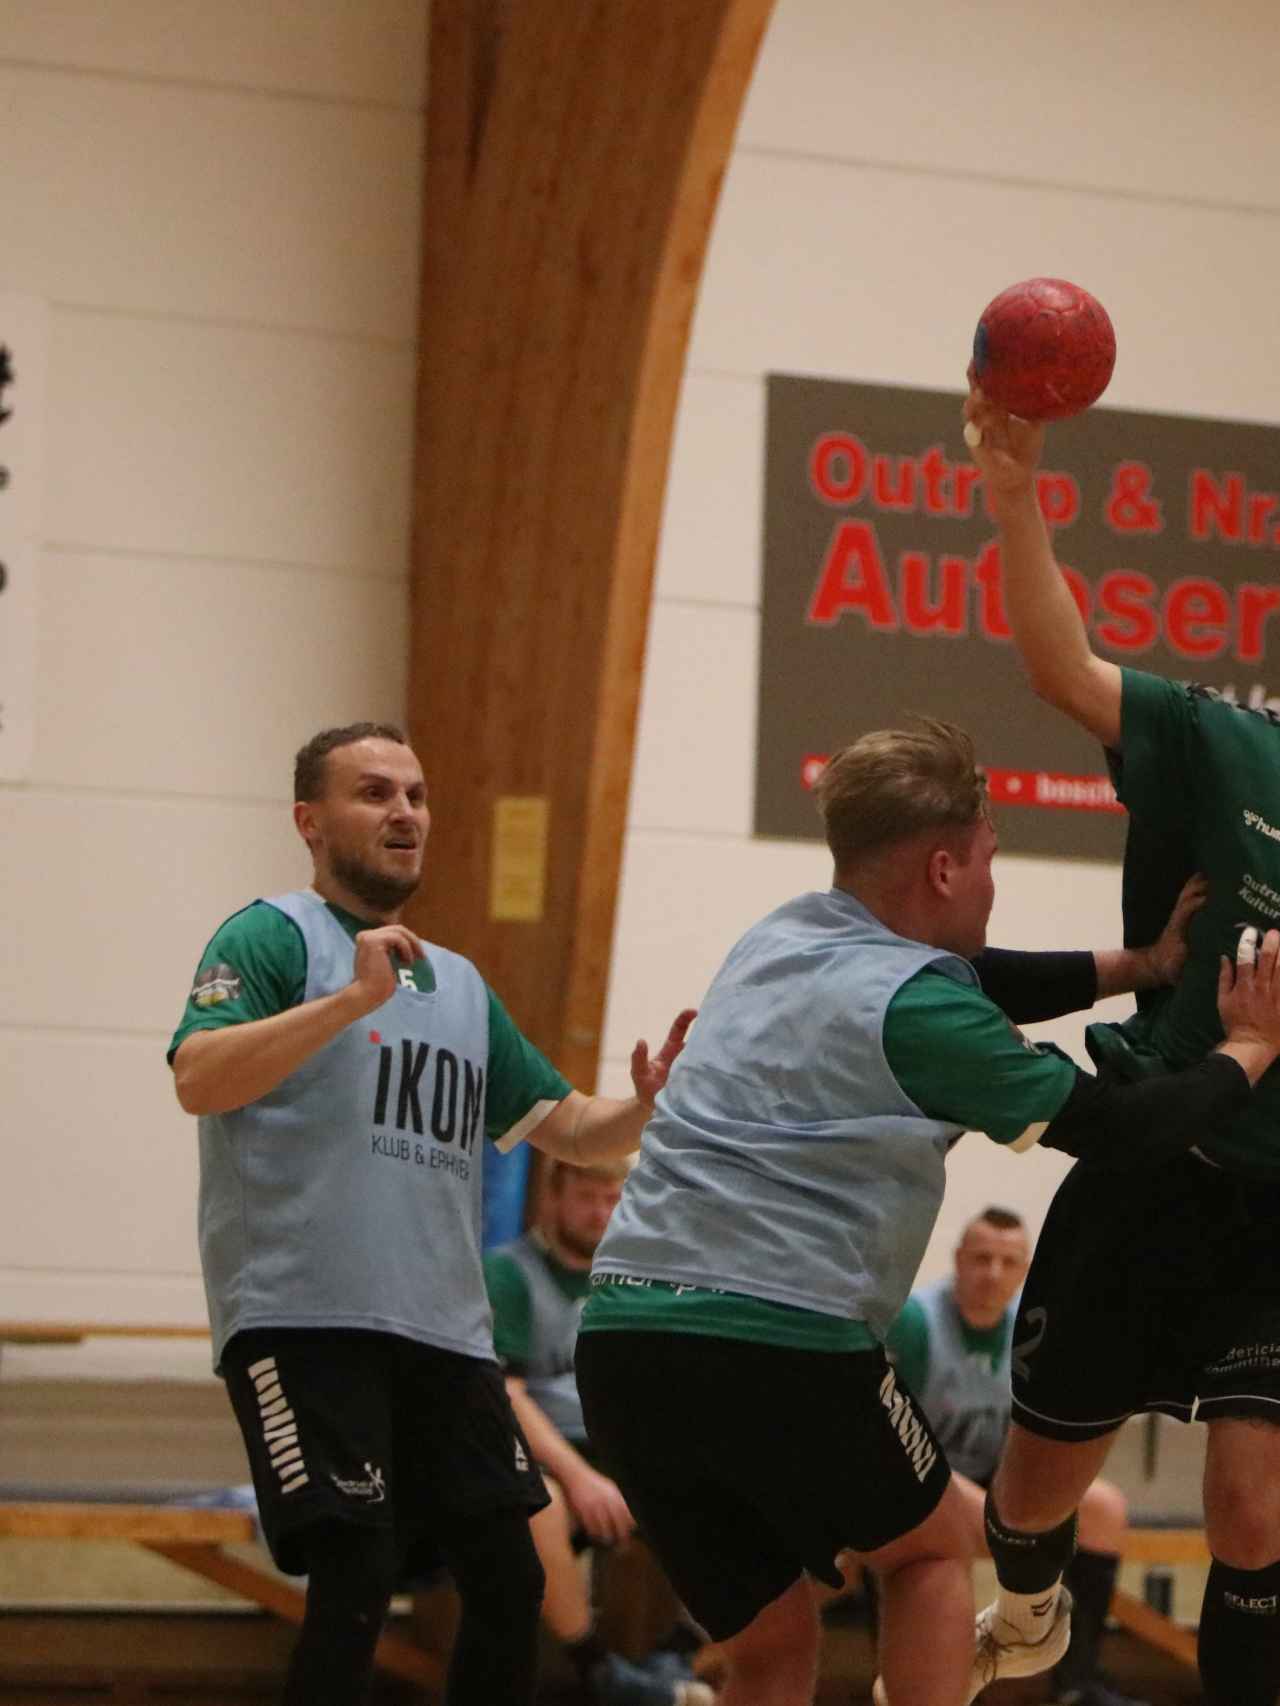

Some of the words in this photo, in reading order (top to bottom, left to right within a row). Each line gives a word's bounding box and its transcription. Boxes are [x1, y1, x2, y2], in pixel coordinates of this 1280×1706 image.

[811, 433, 1080, 527] Outrp
[1107, 462, 1163, 532] &
[372, 1134, 410, 1161] KLUB
[414, 1143, 425, 1165] &
[1223, 1591, 1278, 1610] SELECT
